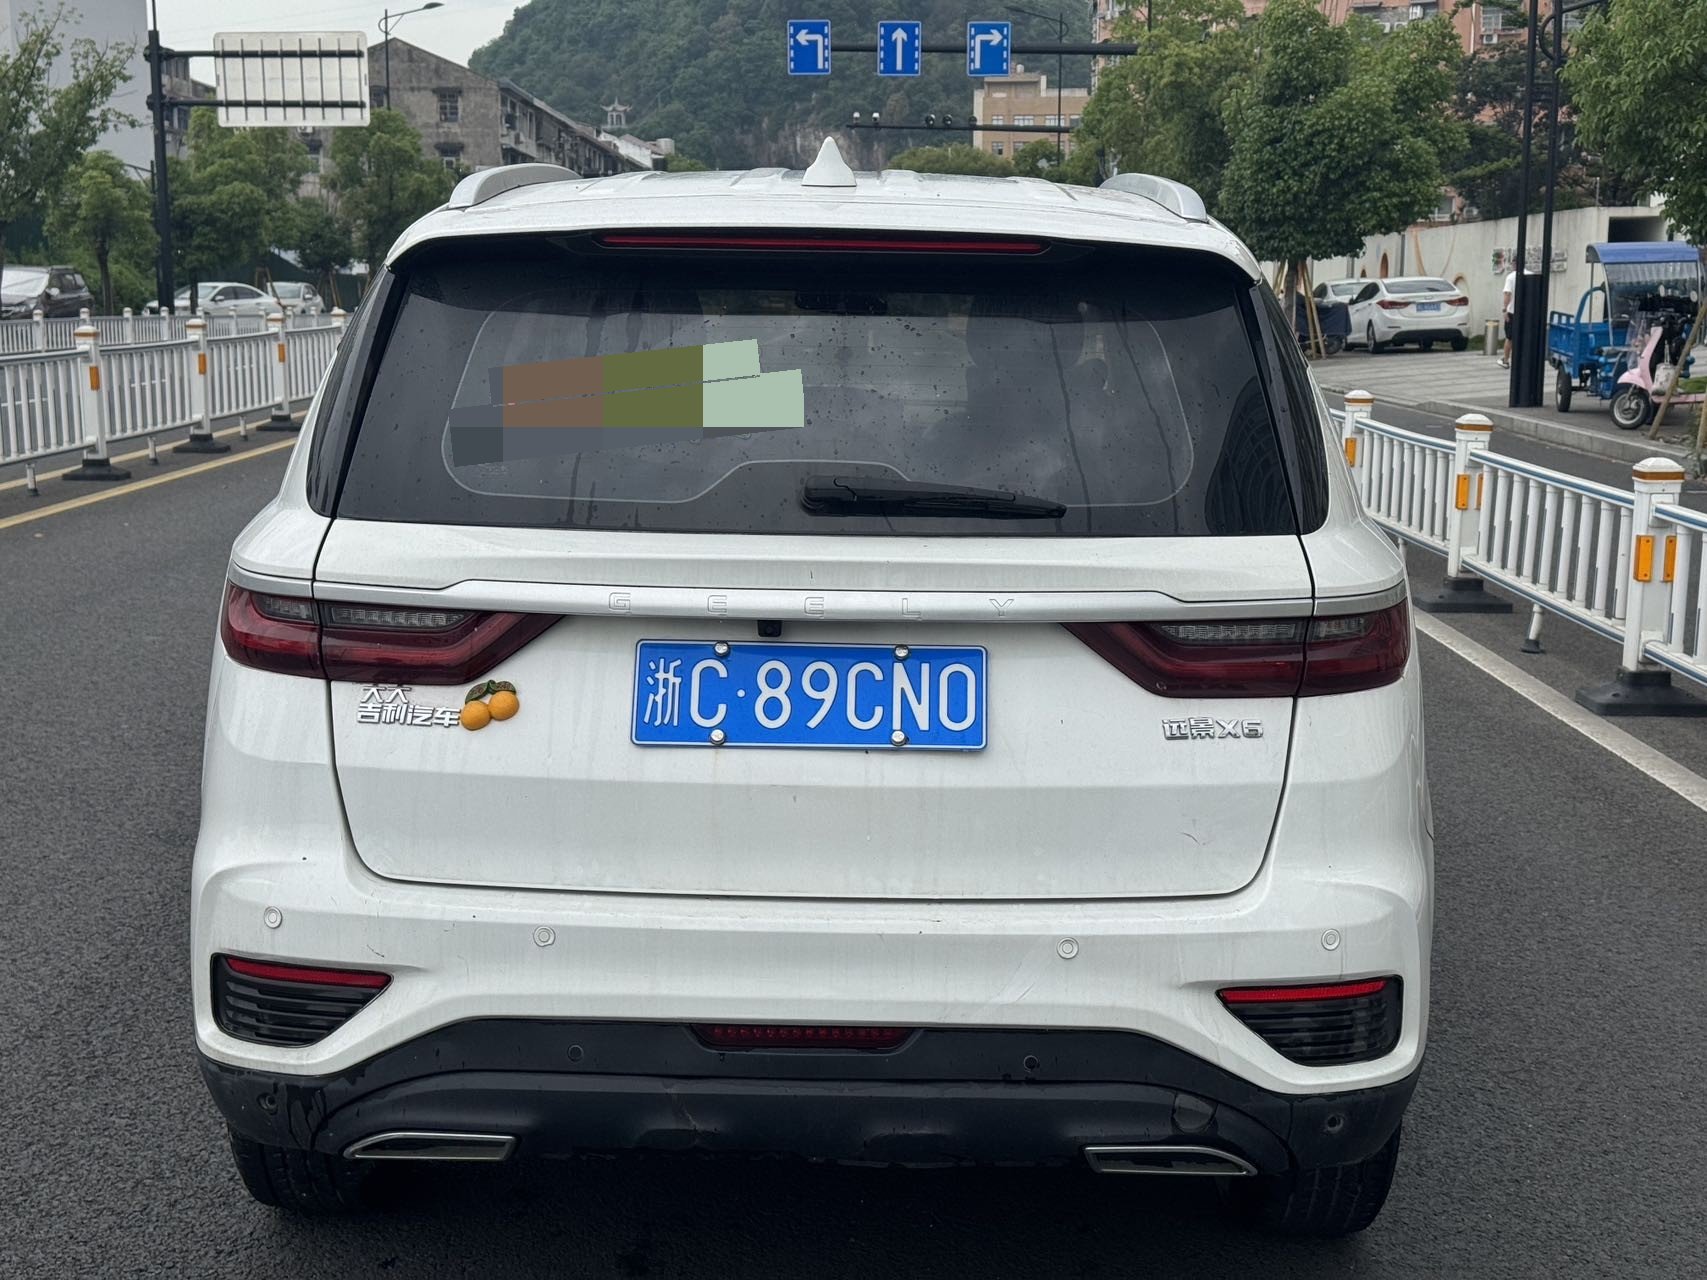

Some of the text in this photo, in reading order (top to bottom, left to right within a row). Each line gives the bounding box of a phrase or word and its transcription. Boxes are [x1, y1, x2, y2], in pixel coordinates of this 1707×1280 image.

[608, 591, 1015, 619] GEELY
[357, 702, 462, 728] 吉利汽车
[1162, 716, 1264, 741] 远景X6
